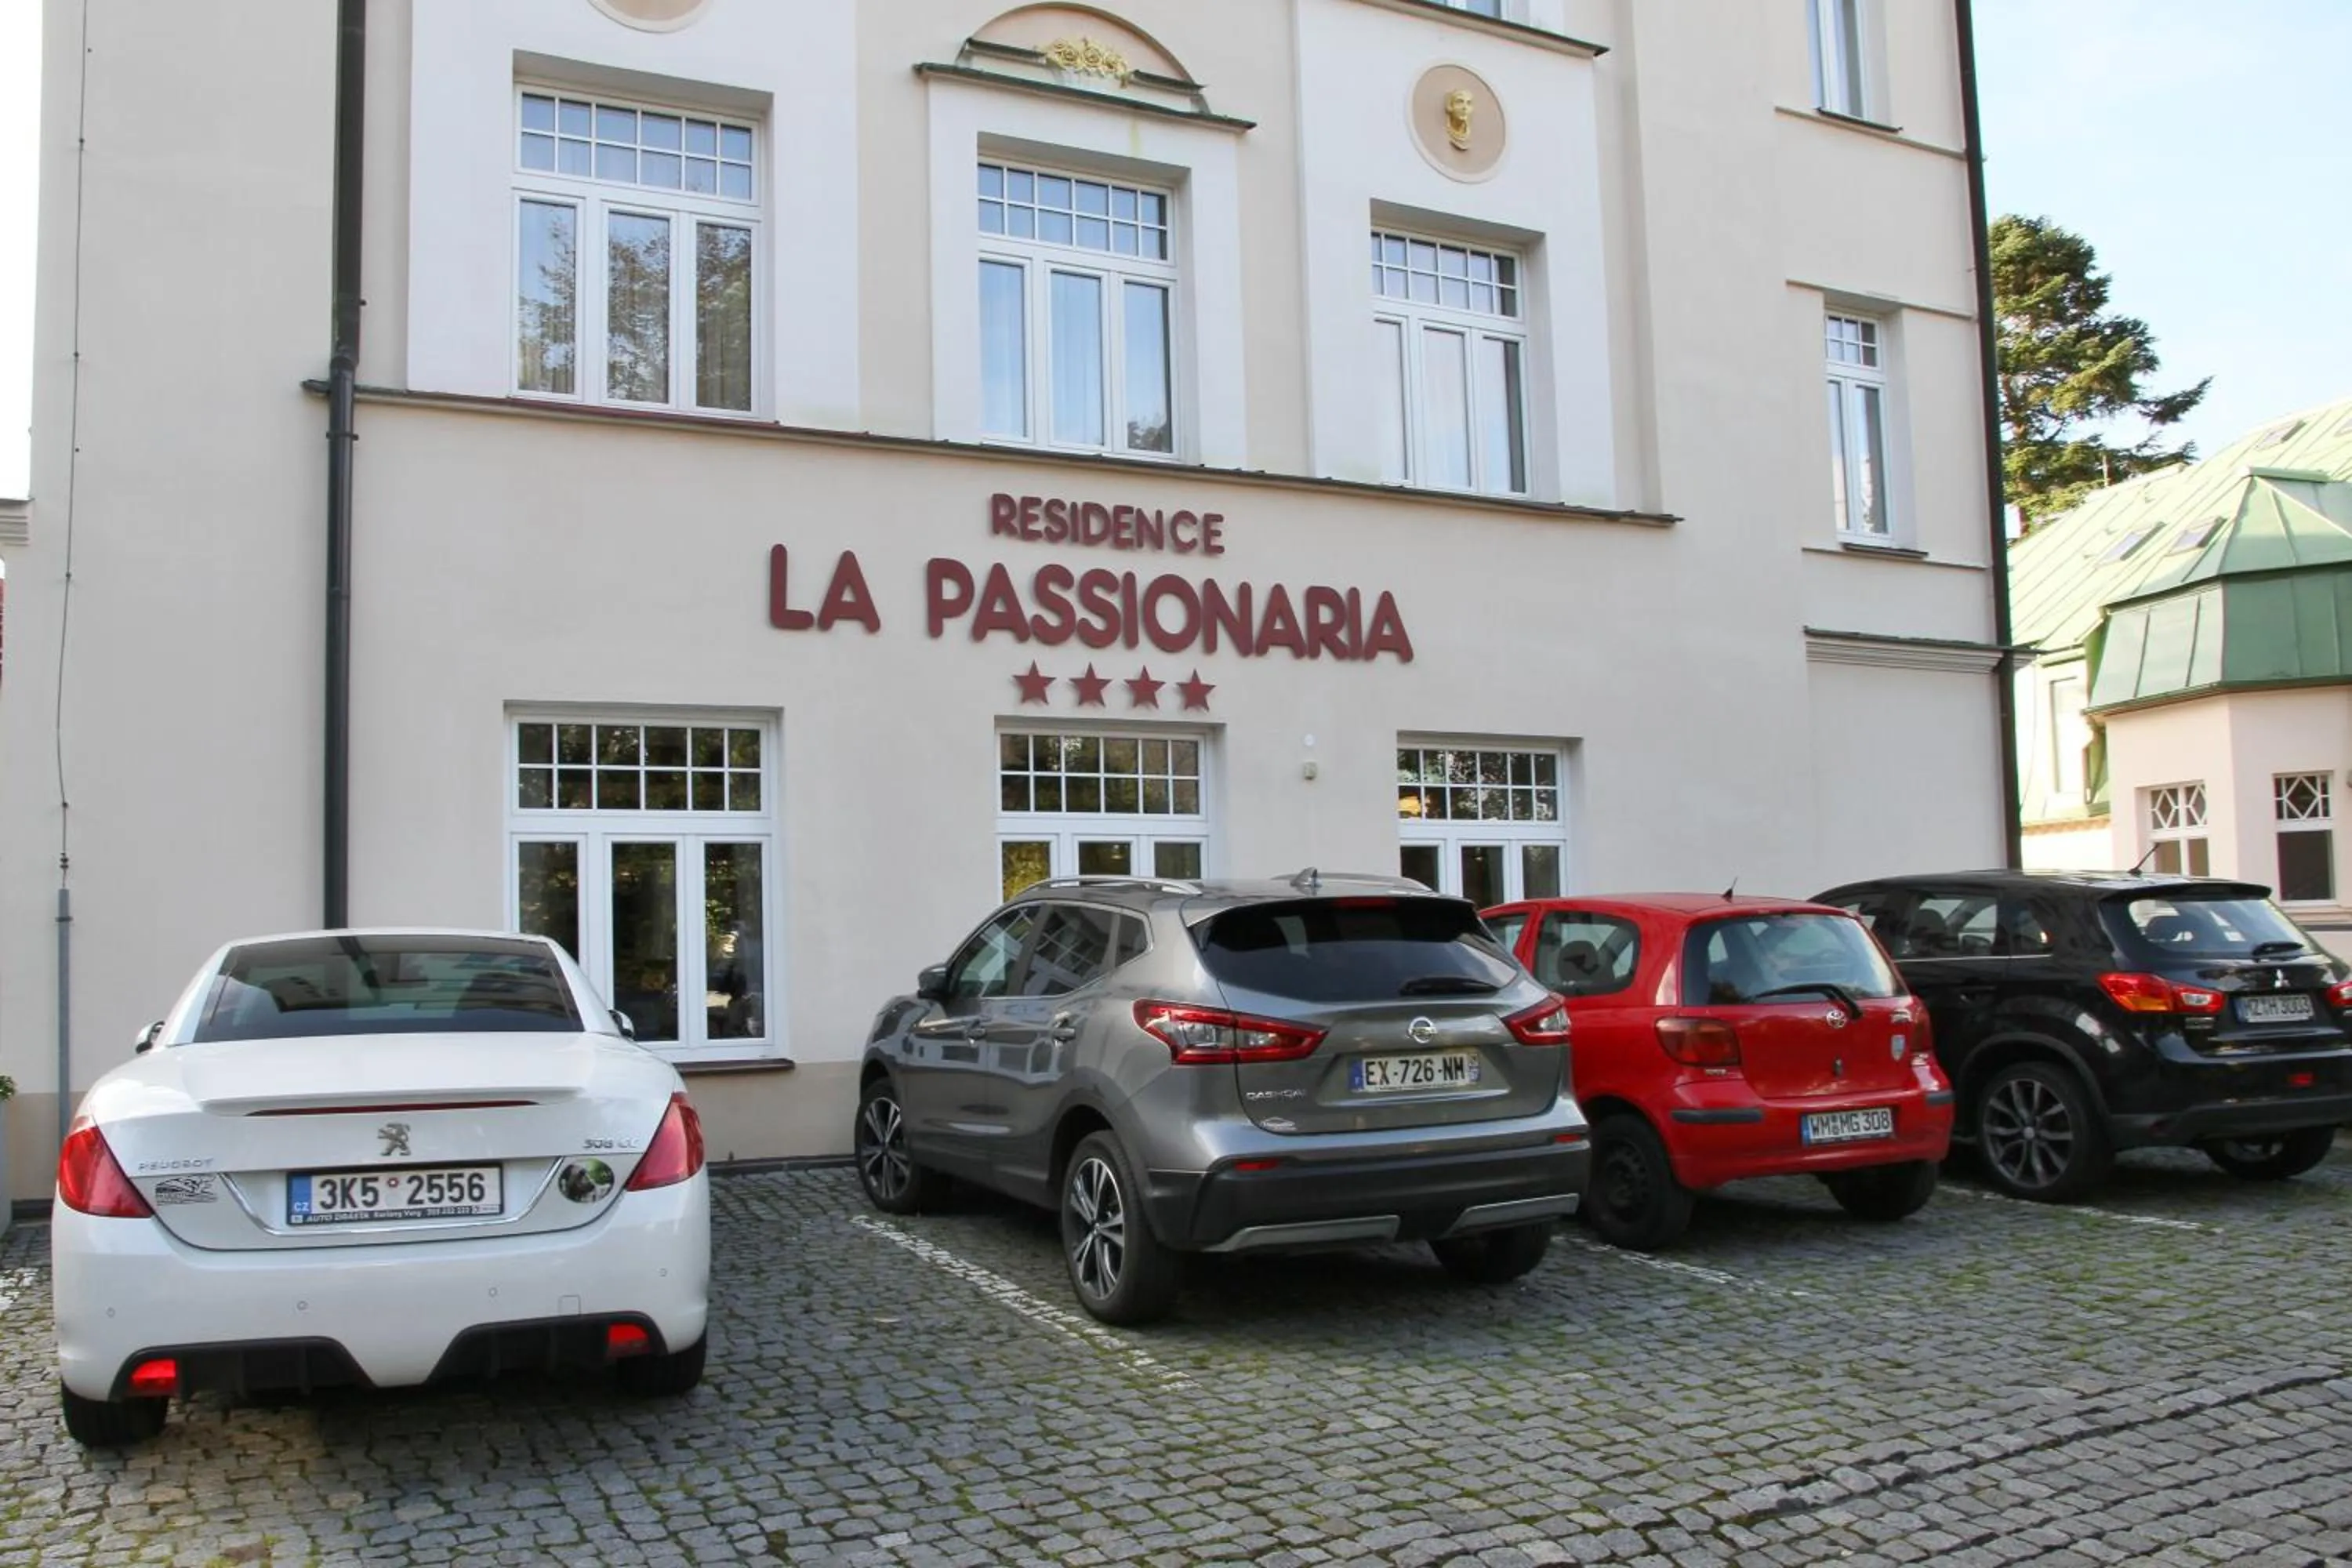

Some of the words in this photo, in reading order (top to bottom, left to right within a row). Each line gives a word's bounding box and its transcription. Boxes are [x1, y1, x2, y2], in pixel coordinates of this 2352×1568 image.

[992, 492, 1225, 555] RESIDENCE
[770, 543, 881, 633] LA
[927, 557, 1414, 663] PASSIONARIA
[1365, 1056, 1465, 1086] EX-726-NM
[1809, 1114, 1831, 1136] WM
[1839, 1112, 1860, 1134] MG
[1862, 1109, 1891, 1131] 308
[138, 1158, 213, 1171] PEUGEOT
[319, 1177, 379, 1210] 3K5
[406, 1173, 486, 1205] 2556
[294, 1203, 310, 1211] CZ
